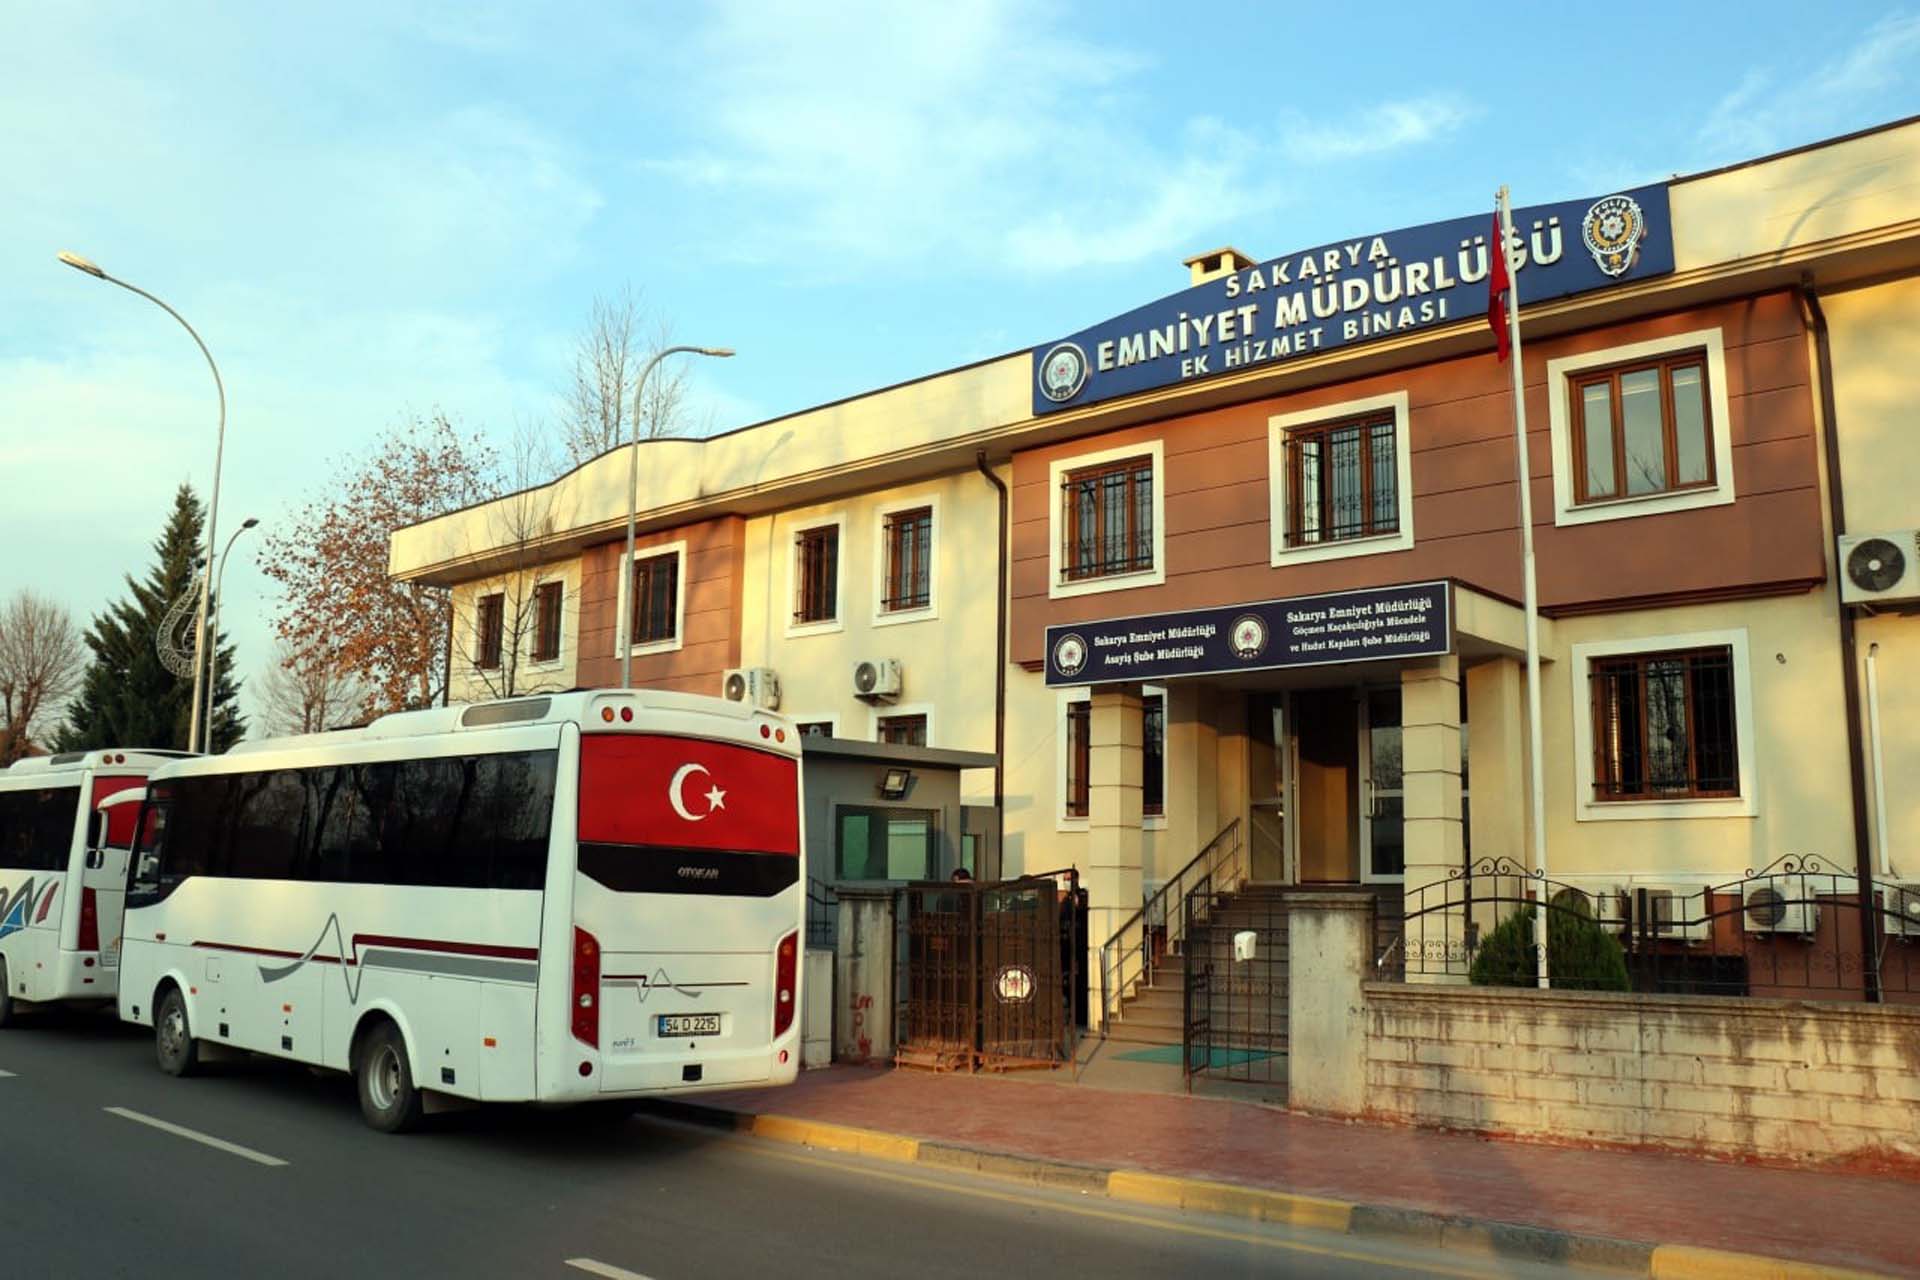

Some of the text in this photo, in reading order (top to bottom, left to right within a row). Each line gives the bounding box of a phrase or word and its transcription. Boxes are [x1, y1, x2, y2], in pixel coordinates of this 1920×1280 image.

[1225, 237, 1391, 298] SAKARYA
[1097, 215, 1563, 372] EMNİYET MÜDÜRLÜĞÜ
[1180, 298, 1449, 380] EK HİZMET BİNASI
[1286, 597, 1432, 624] Sakarya Emniyet Müdürlüğü
[1094, 623, 1216, 648] Sakarya Emniyet Müdürlüğü
[1292, 625, 1326, 637] Göçmen
[1386, 613, 1426, 627] Mücadele
[1289, 644, 1300, 653] ve
[1328, 637, 1360, 651] Kapıları
[1361, 635, 1382, 647] Şube
[1384, 631, 1431, 644] Müdürlüğü
[1104, 645, 1204, 665] Asayiş Şube Müdürlüğü
[677, 866, 720, 880] OTOKAR
[665, 1018, 679, 1031] 54
[682, 1017, 690, 1031] D
